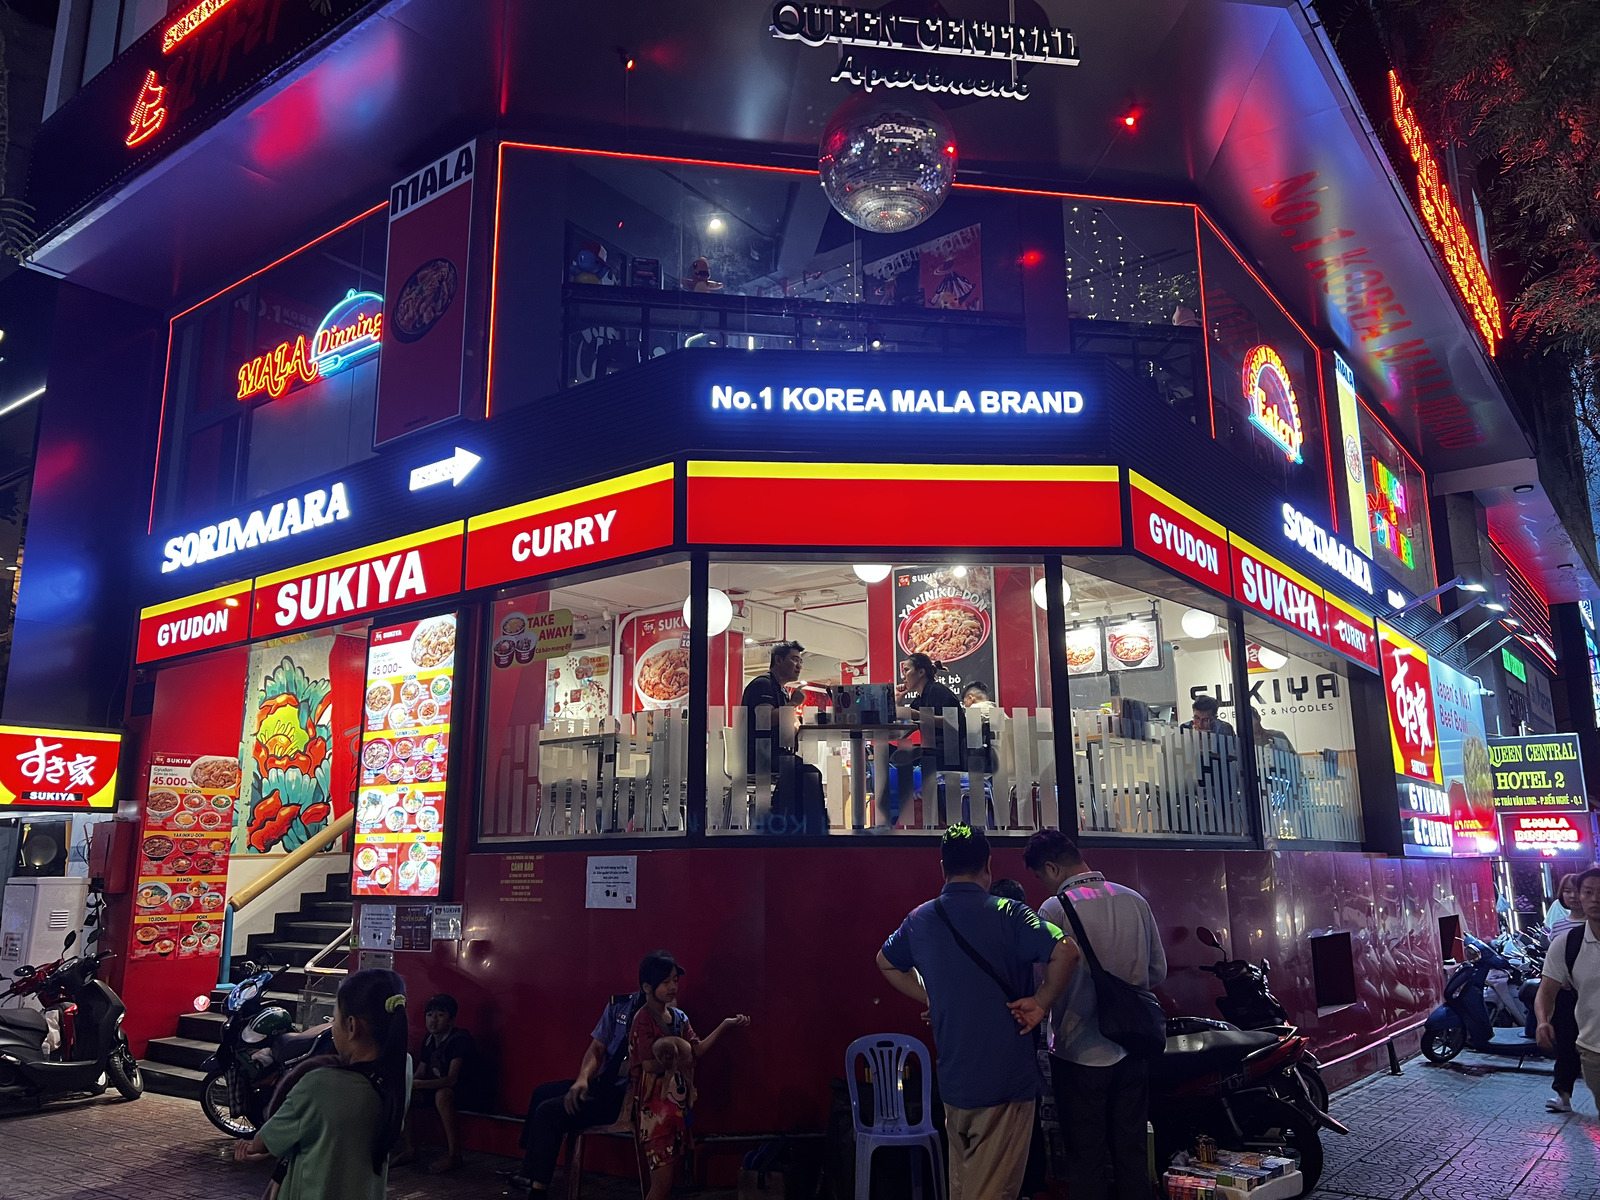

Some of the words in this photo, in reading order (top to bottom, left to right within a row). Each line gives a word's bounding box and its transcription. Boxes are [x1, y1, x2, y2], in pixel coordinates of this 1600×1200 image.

[769, 0, 903, 47] QUEEN
[918, 17, 1081, 62] CENTRAL
[831, 54, 1030, 100] Apartment
[390, 146, 473, 217] MALA
[317, 312, 383, 355] Dinning
[237, 334, 318, 400] MALA
[1335, 355, 1354, 388] MALA
[711, 385, 772, 410] No.1
[782, 388, 887, 412] KOREA
[892, 389, 976, 414] MALA
[980, 391, 1084, 415] BRAND
[1256, 386, 1297, 461] Eatery
[161, 481, 350, 573] SORIMMARA
[511, 509, 617, 562] CURRY
[1149, 512, 1219, 575] GYUDON
[274, 549, 427, 628] SUKIYA
[911, 572, 944, 583] SUKIYA
[899, 587, 987, 620] YAKINIKU-DON
[1241, 556, 1322, 636] SUKIYA
[157, 608, 228, 648] GYUDON
[528, 614, 555, 628] TAKE
[538, 625, 573, 641] AWAY!
[1338, 620, 1367, 653] CURRY
[949, 674, 961, 684] bò
[1190, 673, 1340, 707] SUKIYA
[1436, 676, 1459, 706] Japan's
[1458, 687, 1472, 711] No.1
[1281, 702, 1334, 714] NOODLES
[1439, 704, 1454, 729] Beef
[16, 737, 97, 791] すき家
[1488, 744, 1523, 767] QUEEN
[1525, 742, 1578, 762] CENTRAL
[29, 791, 76, 802] SUKIYA
[1495, 770, 1552, 790] HOTEL
[1554, 771, 1565, 788] 2
[1408, 783, 1451, 816] GYUDON
